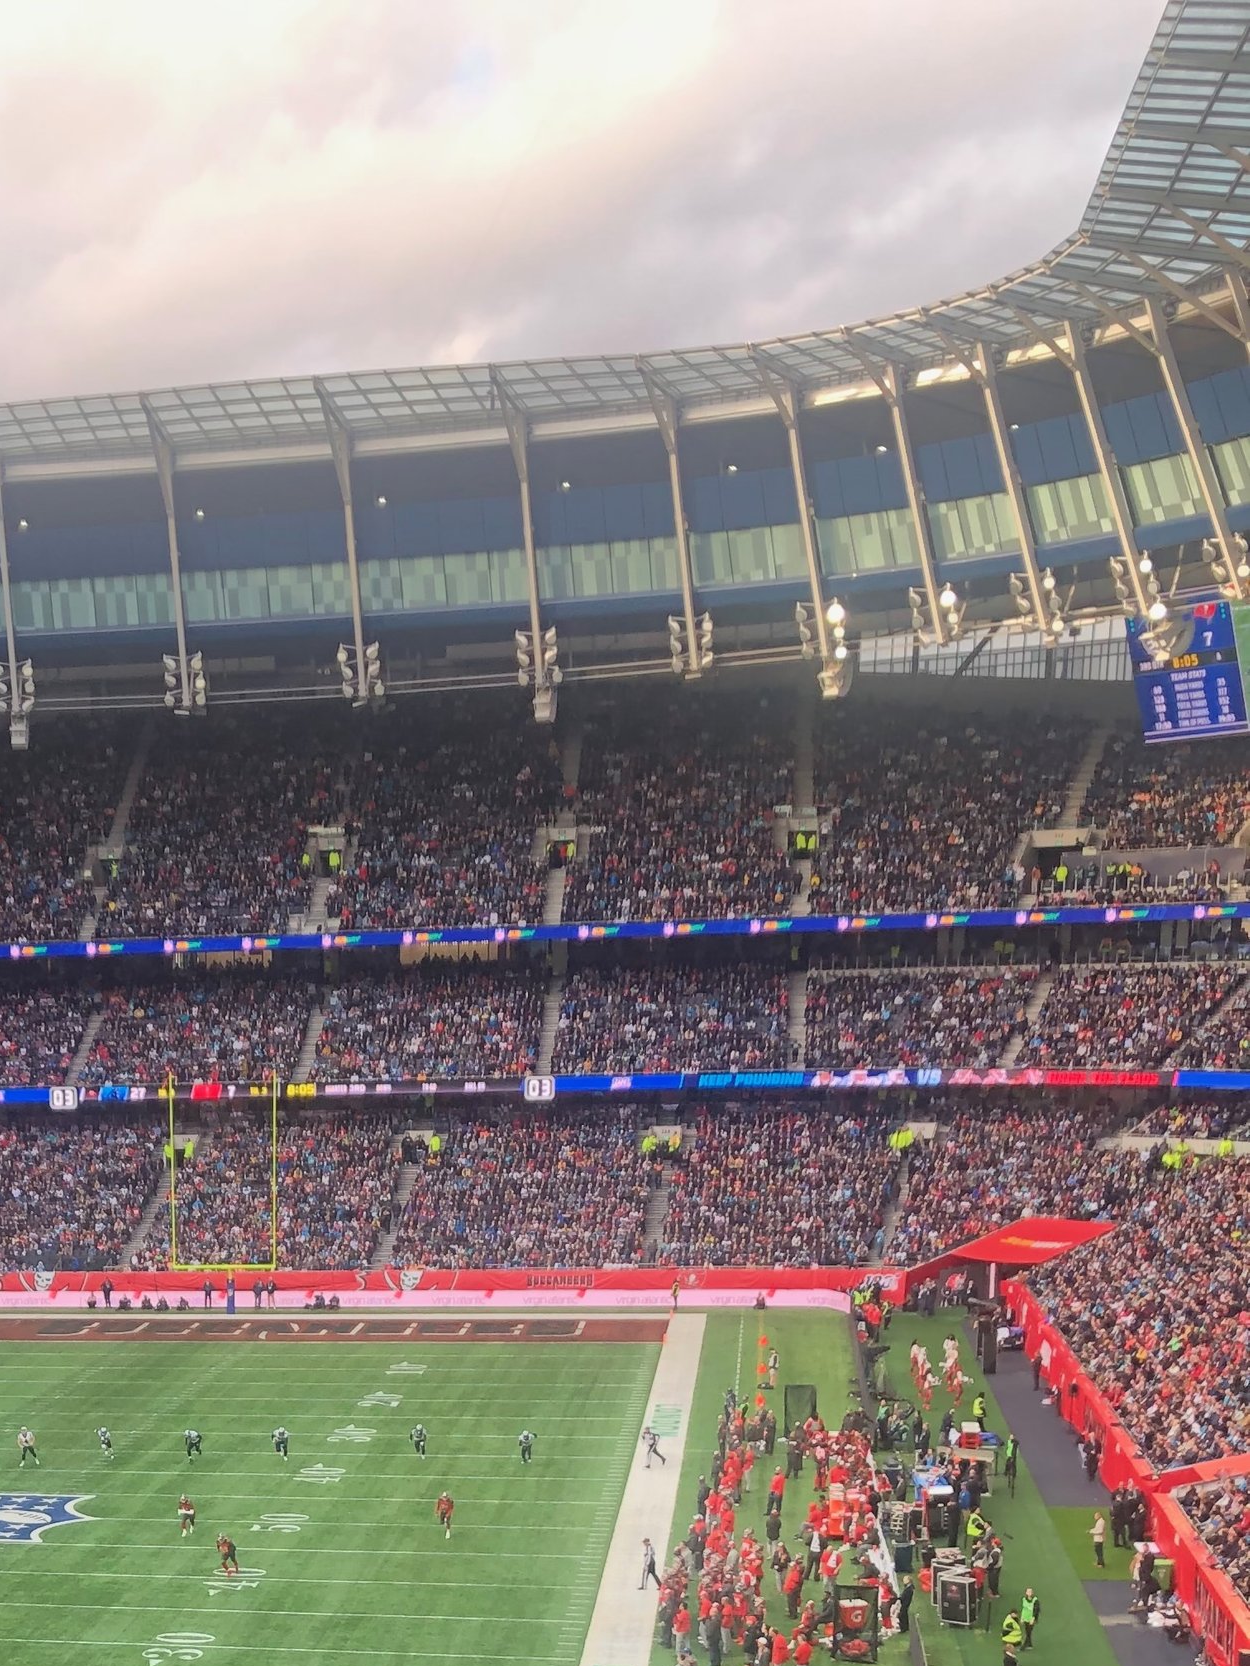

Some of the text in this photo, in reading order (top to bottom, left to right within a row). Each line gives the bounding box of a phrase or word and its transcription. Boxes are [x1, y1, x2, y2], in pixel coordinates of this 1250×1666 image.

[1203, 631, 1213, 646] 7
[699, 1071, 803, 1088] KEEP POUNDING
[916, 1069, 941, 1085] VS
[130, 1087, 146, 1100] 27
[286, 1084, 315, 1098] 8:05
[529, 1079, 551, 1097] 03
[53, 1090, 73, 1106] 03
[526, 1273, 594, 1288] BUCCANEERS
[383, 1360, 428, 1375] 10
[356, 1391, 404, 1408] 20
[326, 1424, 378, 1443] 30
[293, 1466, 347, 1485] 40
[258, 1512, 311, 1533] 50
[202, 1566, 268, 1594] 40
[140, 1631, 217, 1662] 30
